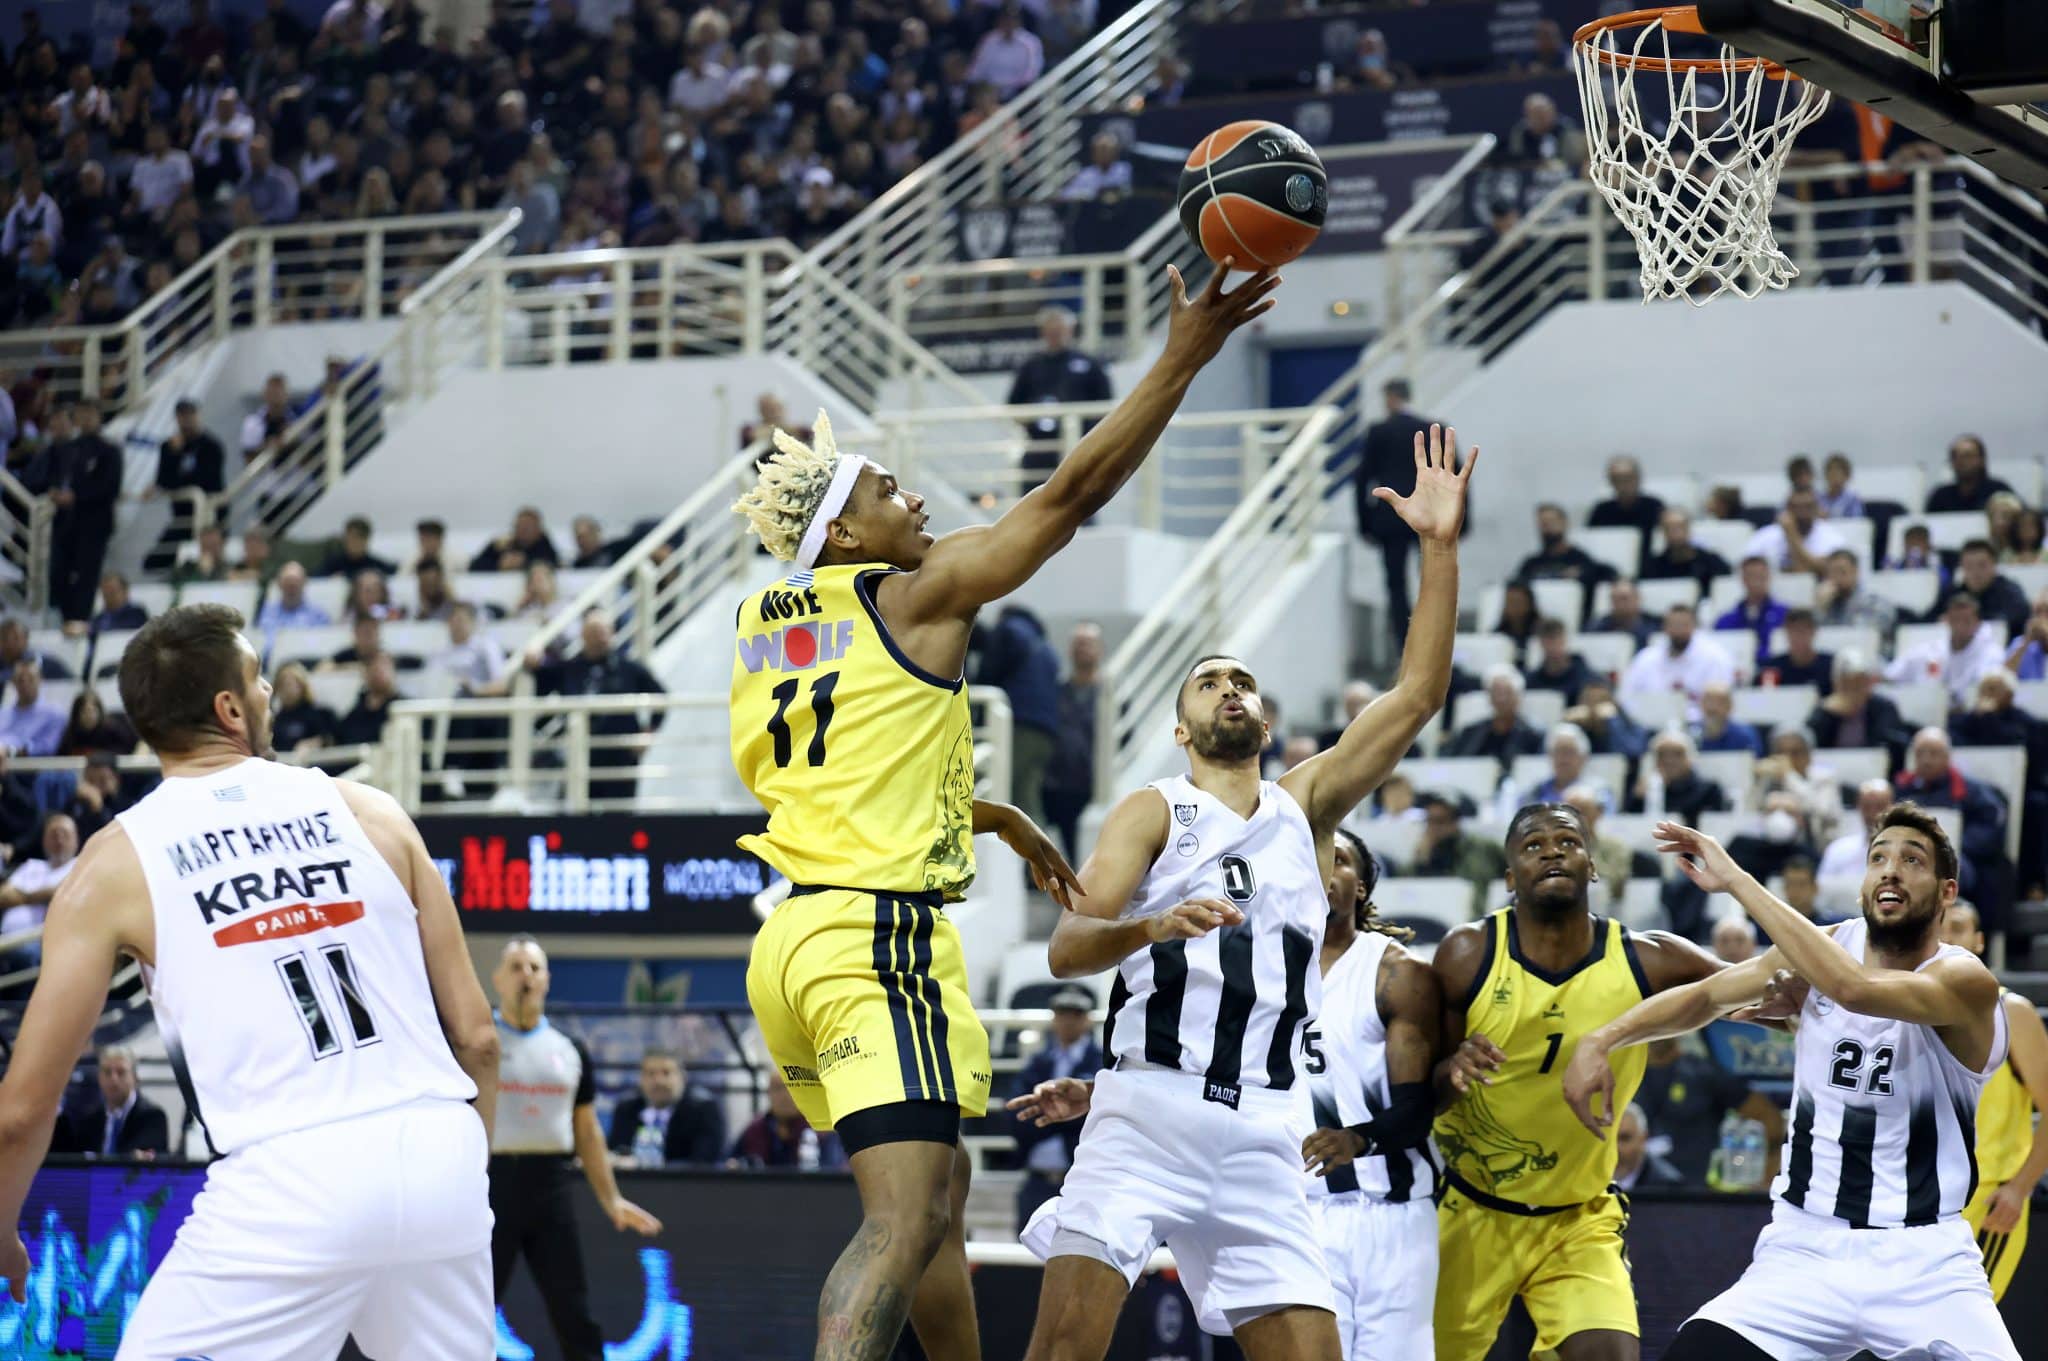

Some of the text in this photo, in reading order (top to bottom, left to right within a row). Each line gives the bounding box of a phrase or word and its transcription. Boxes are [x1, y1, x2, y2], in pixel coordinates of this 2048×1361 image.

[738, 619, 854, 674] WOLF
[767, 671, 840, 768] 11
[193, 859, 352, 925] KRAFT
[461, 831, 650, 912] Molinari
[1218, 852, 1257, 903] 0
[274, 943, 383, 1061] 11
[1537, 1032, 1564, 1075] 1
[1828, 1038, 1894, 1096] 22
[1208, 1084, 1237, 1103] PAOK
